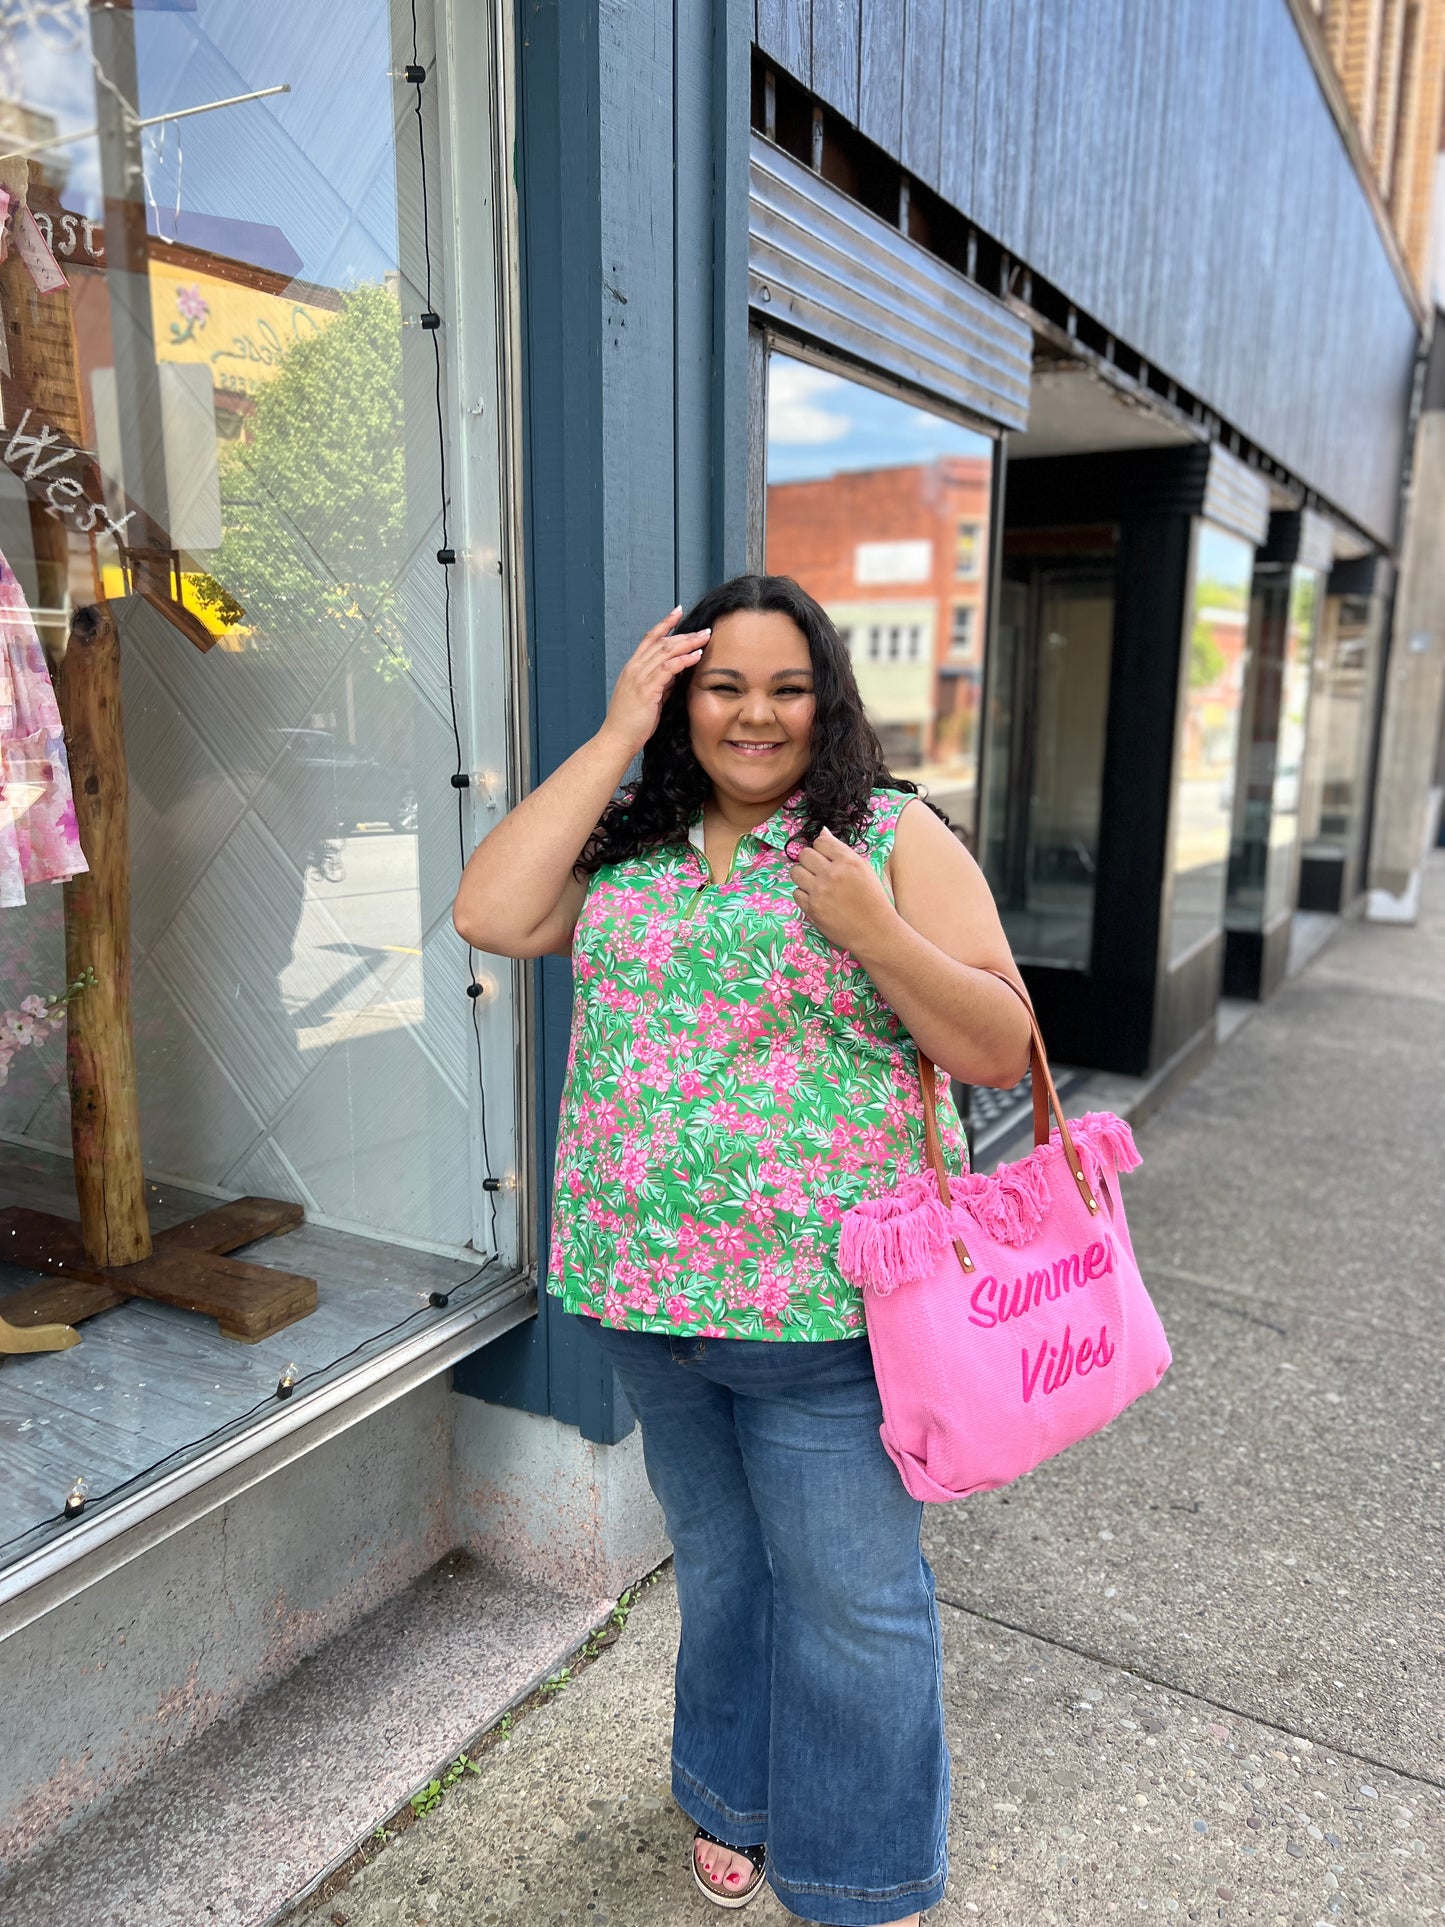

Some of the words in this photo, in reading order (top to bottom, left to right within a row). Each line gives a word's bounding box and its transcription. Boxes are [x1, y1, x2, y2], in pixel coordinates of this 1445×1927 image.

[33, 212, 104, 258] ast
[4, 408, 136, 536] West
[1021, 1325, 1114, 1403] Vibes
